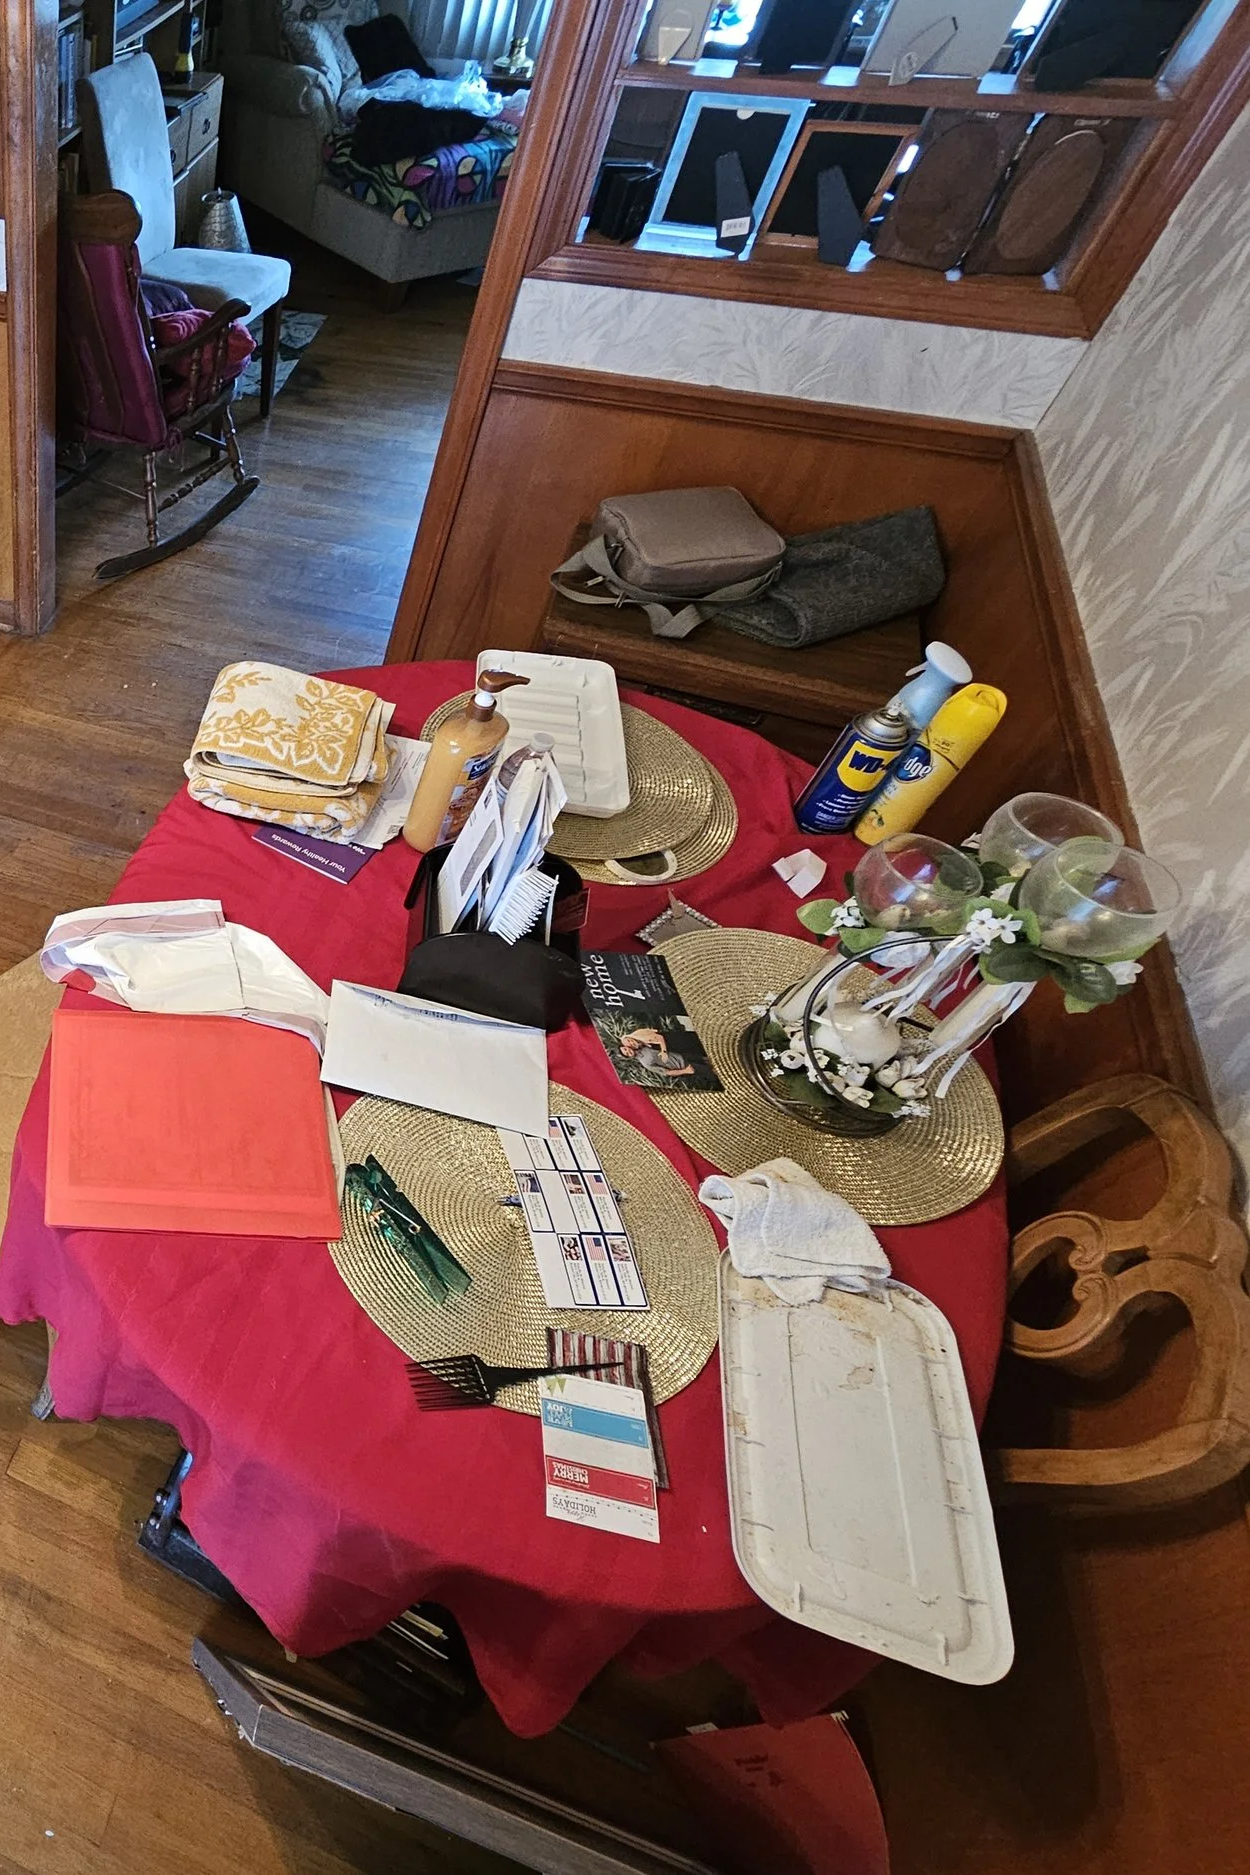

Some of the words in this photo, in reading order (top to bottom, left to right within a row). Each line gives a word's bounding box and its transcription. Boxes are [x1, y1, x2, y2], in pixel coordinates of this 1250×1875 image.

[271, 833, 303, 852] Rewards
[302, 847, 330, 866] Healthy
[329, 860, 346, 873] Your
[580, 963, 606, 1000] new
[590, 954, 625, 1008] home
[553, 1467, 589, 1484] MERRY
[552, 1496, 597, 1515] HOLIDAYS
